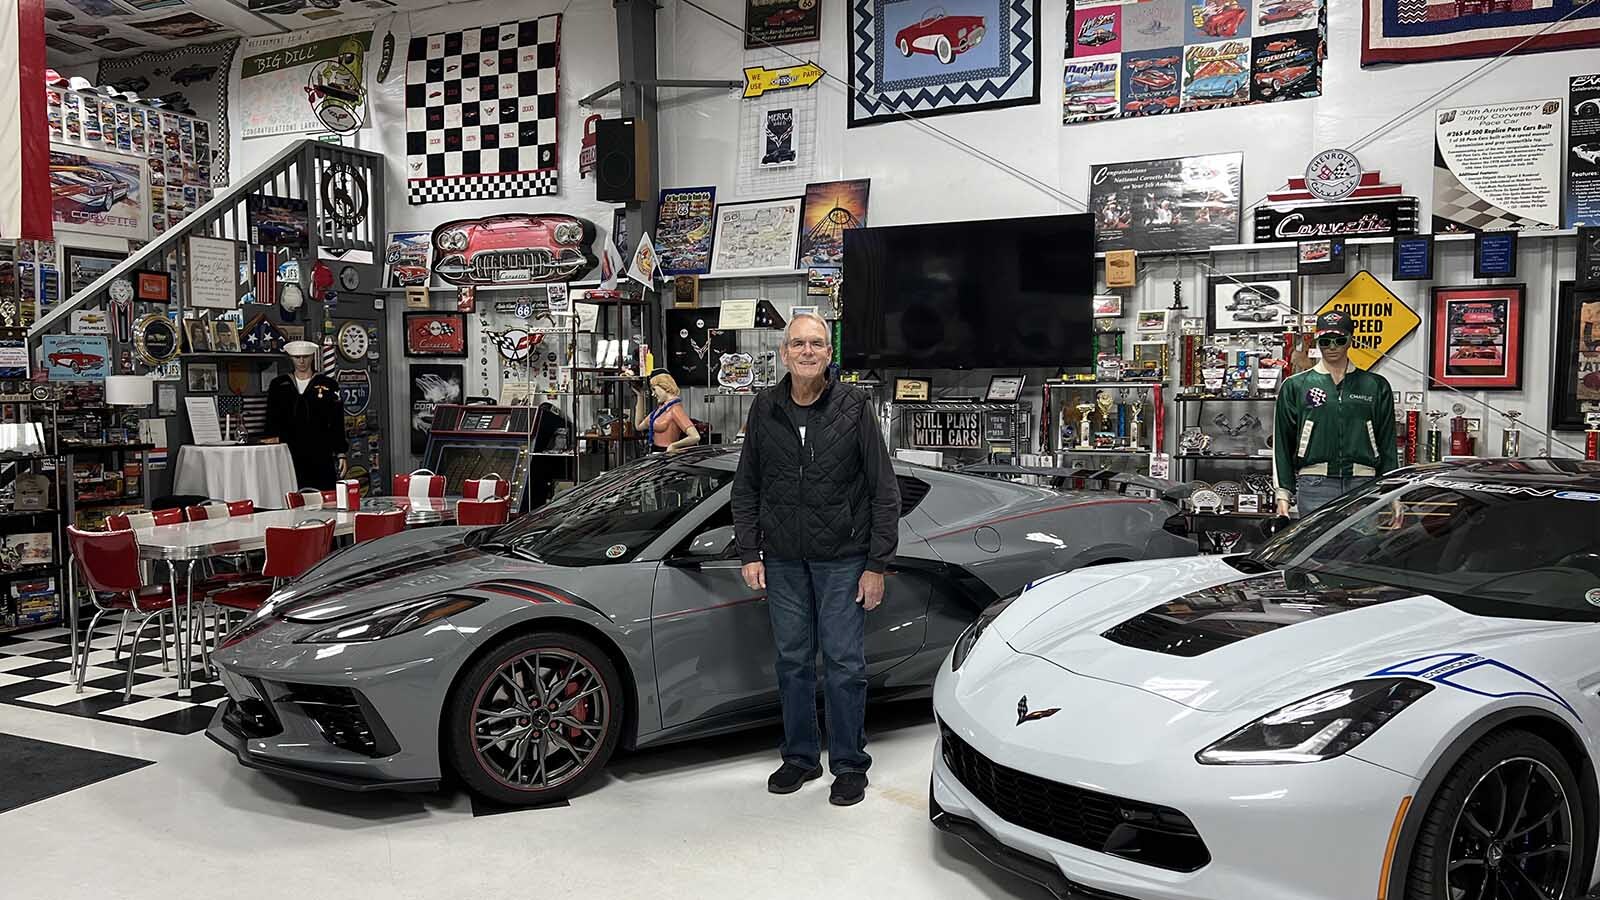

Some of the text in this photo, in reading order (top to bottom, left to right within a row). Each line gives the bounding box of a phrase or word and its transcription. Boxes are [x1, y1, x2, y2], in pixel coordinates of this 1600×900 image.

[1482, 104, 1540, 114] Anniversary
[1491, 111, 1532, 119] Corvette
[242, 124, 296, 136] CONGRATULATIONS
[1311, 152, 1356, 173] CHEVROLET
[1094, 166, 1147, 185] Congratulations
[72, 210, 137, 228] CORVETTE
[1274, 213, 1392, 238] Corvette
[388, 252, 400, 262] 66
[500, 272, 528, 280] Corvette
[518, 306, 530, 315] 66
[1334, 303, 1392, 316] CAUTION
[1352, 320, 1383, 333] PEED
[419, 339, 451, 348] Corvette
[1352, 336, 1382, 349] UMP
[344, 388, 366, 404] 25th
[916, 412, 977, 429] STILL PLAYS
[916, 430, 977, 446] WITH CARS
[1422, 660, 1469, 678] CARBON
